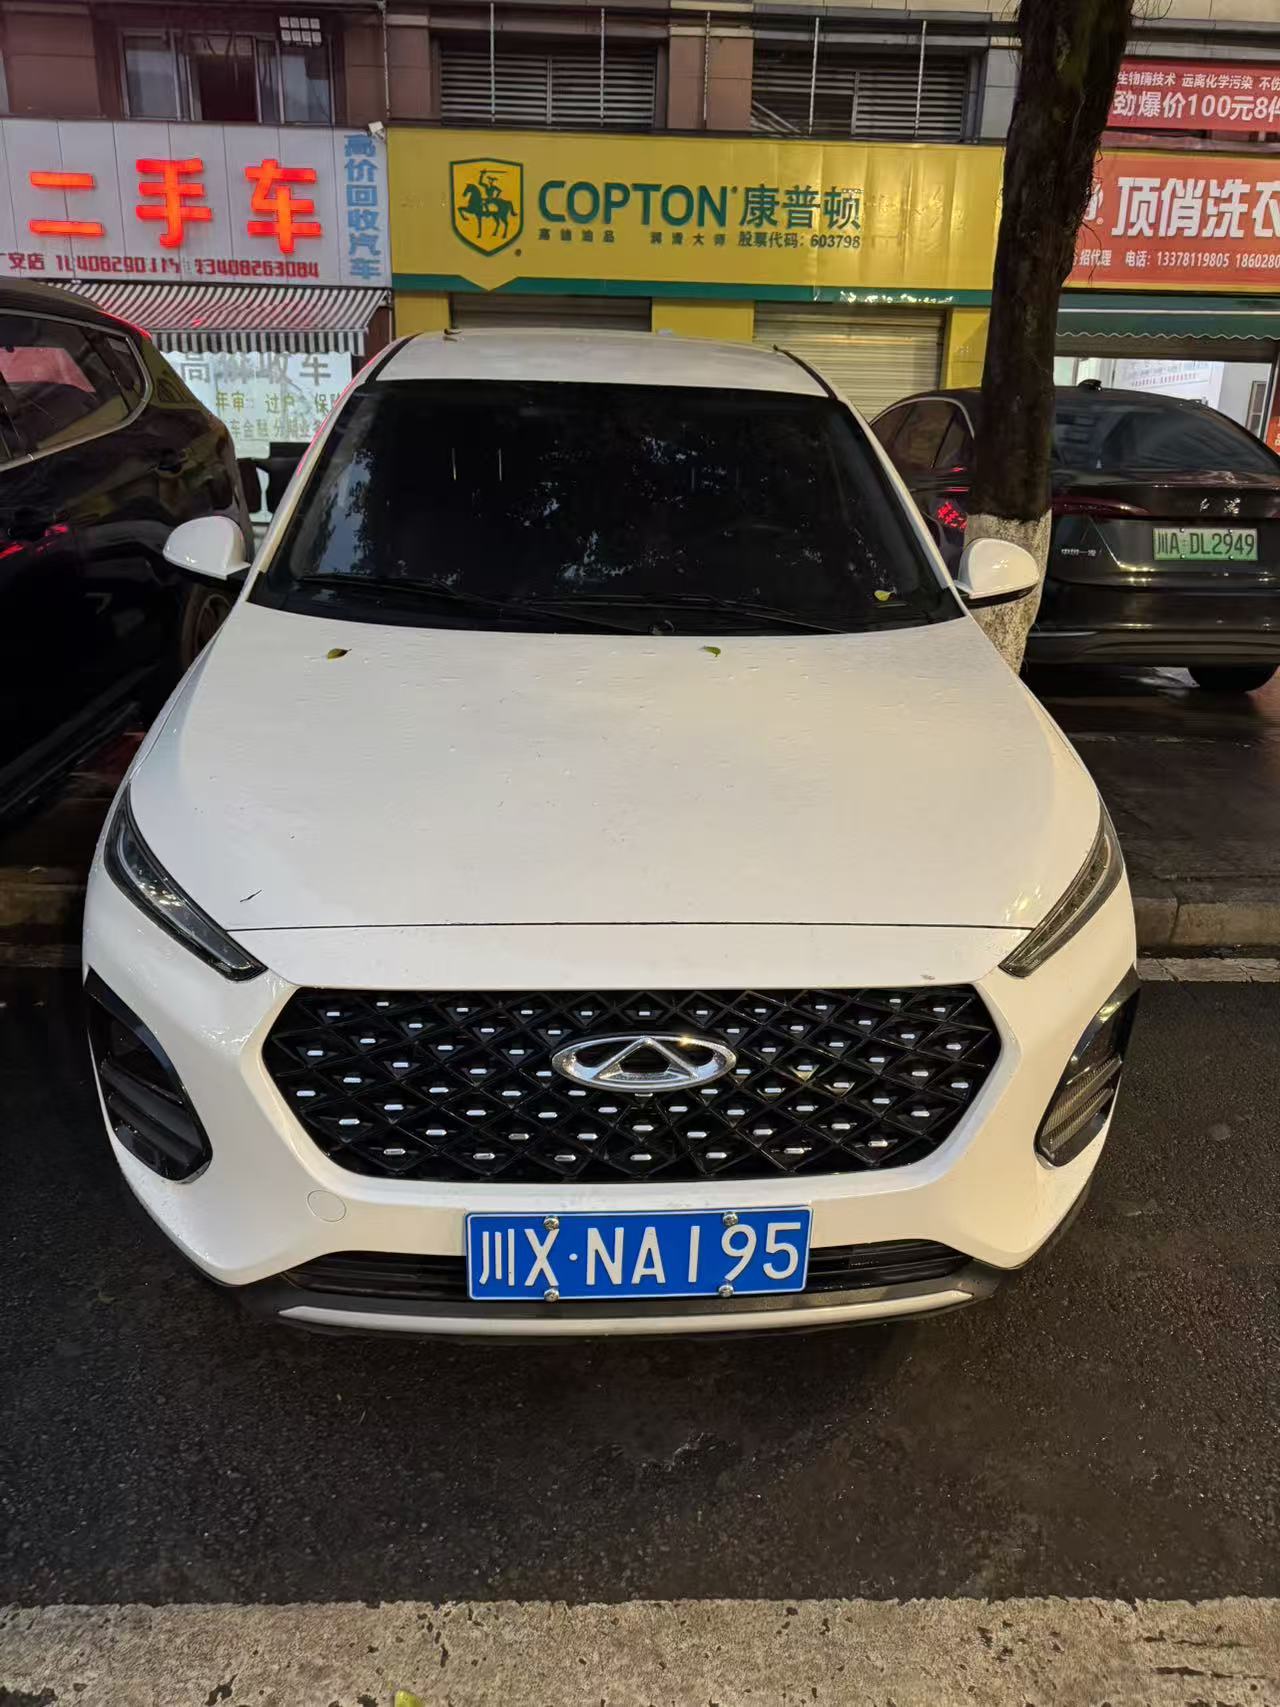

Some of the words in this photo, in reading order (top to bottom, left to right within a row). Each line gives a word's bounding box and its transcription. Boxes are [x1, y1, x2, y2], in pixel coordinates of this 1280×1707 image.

[1182, 73, 1253, 90] 远离化学污染
[29, 158, 322, 254] 二手车
[344, 134, 382, 279] 高价回收汽车
[538, 180, 727, 228] COPTON
[737, 183, 862, 231] 康普顿
